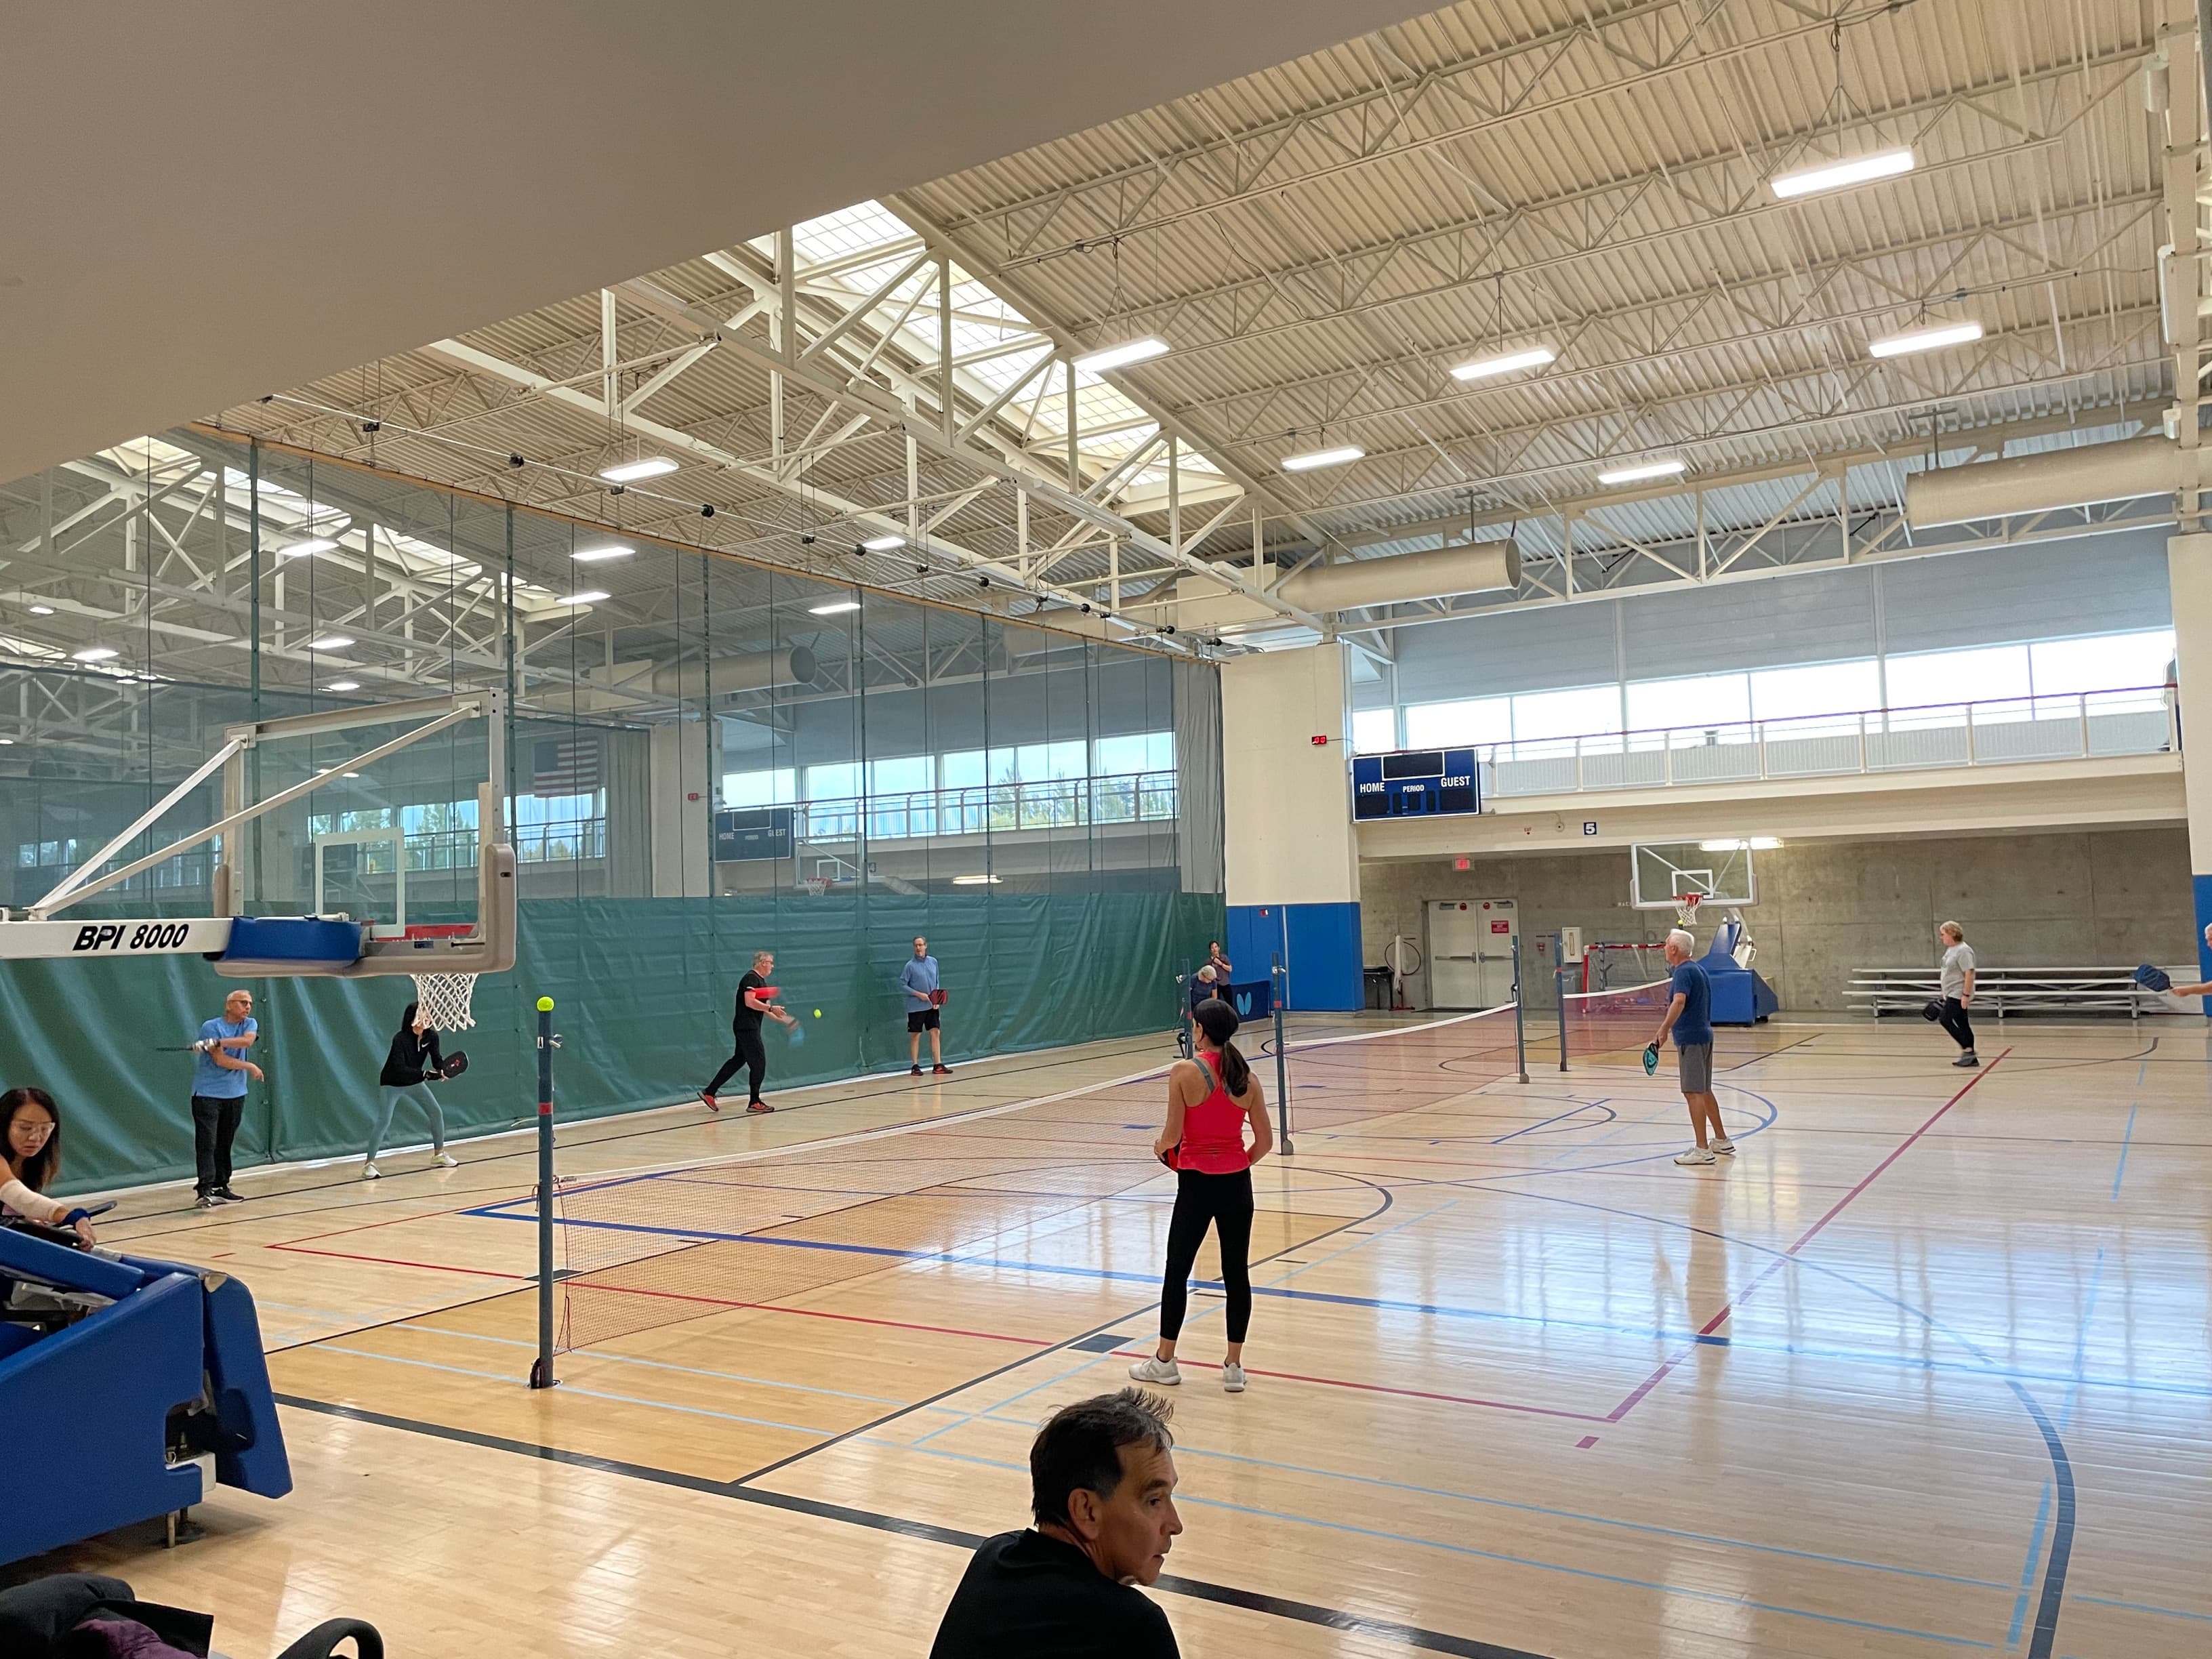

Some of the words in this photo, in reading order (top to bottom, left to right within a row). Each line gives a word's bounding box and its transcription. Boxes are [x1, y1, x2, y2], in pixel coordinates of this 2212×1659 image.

[1359, 782, 1385, 794] HOME
[1402, 785, 1425, 793] PERIOD
[1441, 776, 1471, 787] GUEST
[1586, 823, 1595, 834] 5
[719, 832, 735, 840] HOME
[73, 924, 127, 951] BPI
[129, 924, 189, 949] 8000
